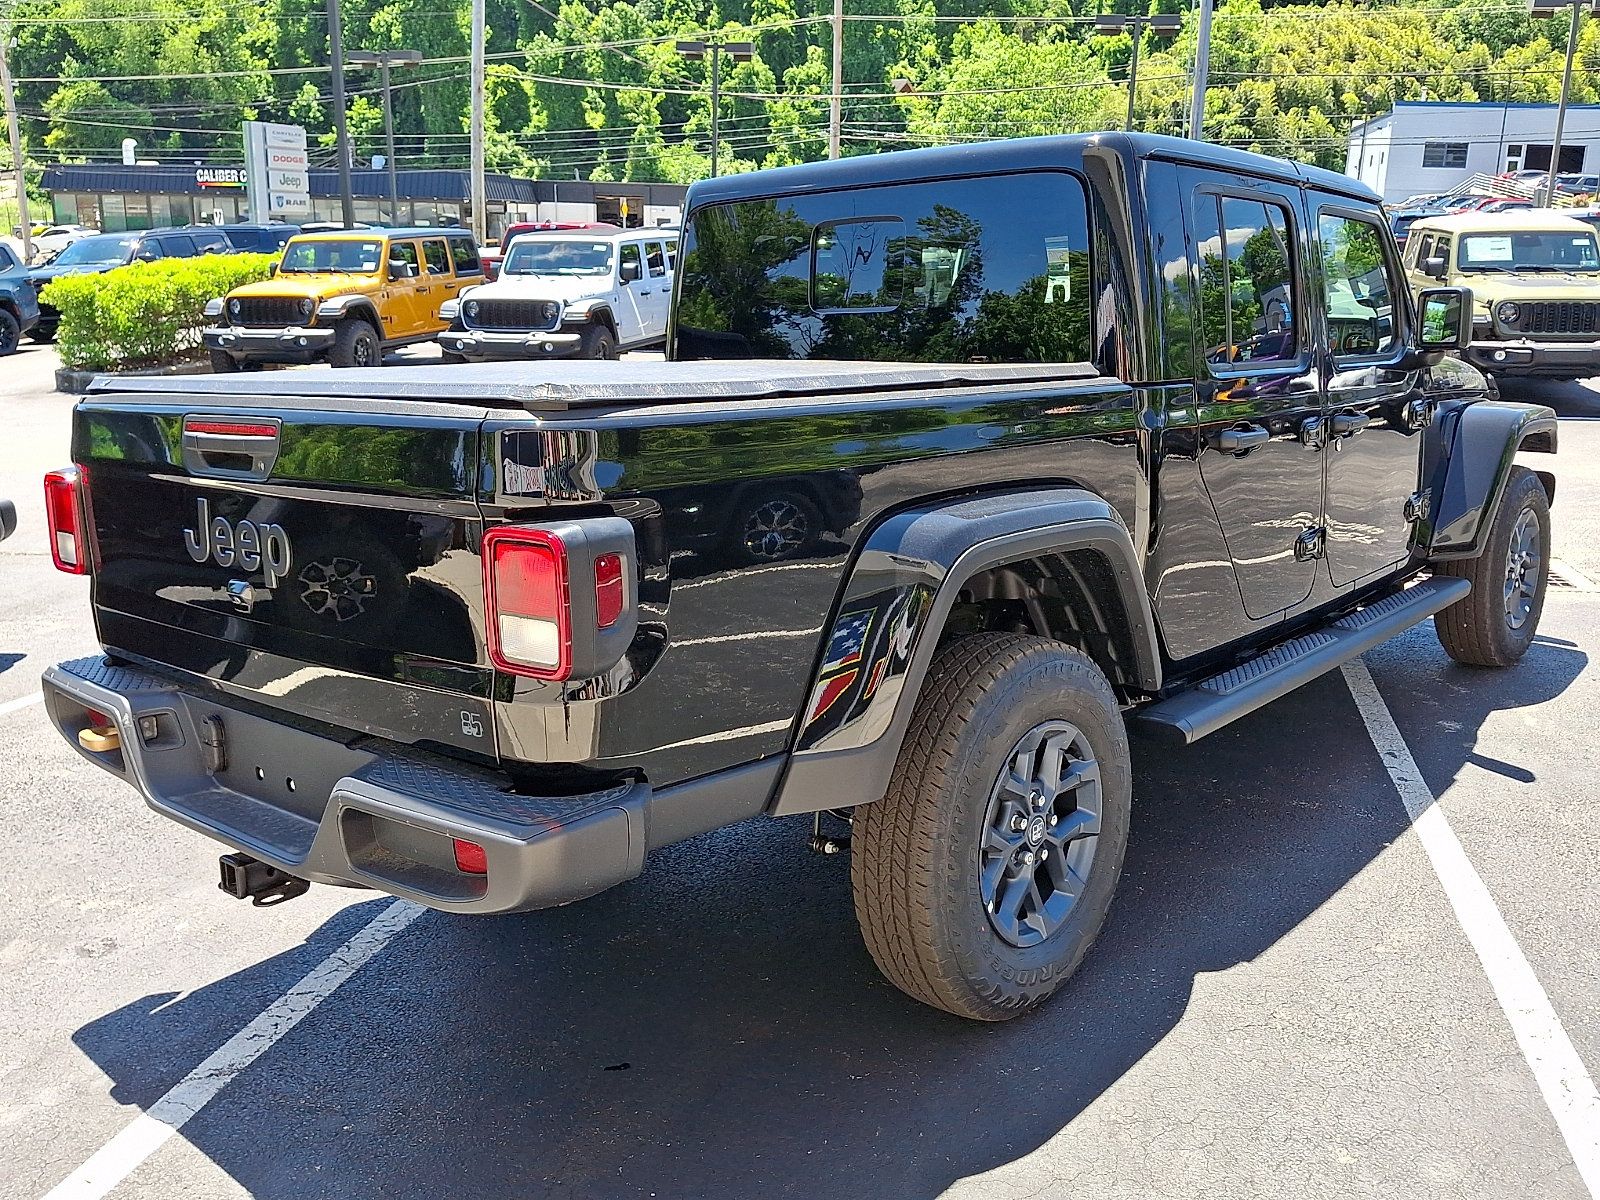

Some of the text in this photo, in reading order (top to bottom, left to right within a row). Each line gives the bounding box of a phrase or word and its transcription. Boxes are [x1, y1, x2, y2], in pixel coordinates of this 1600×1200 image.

[273, 155, 304, 164] DODGE
[196, 168, 239, 182] CALIBER
[279, 173, 301, 189] Jeep
[183, 497, 292, 589] Jeep
[460, 710, 484, 738] 85
